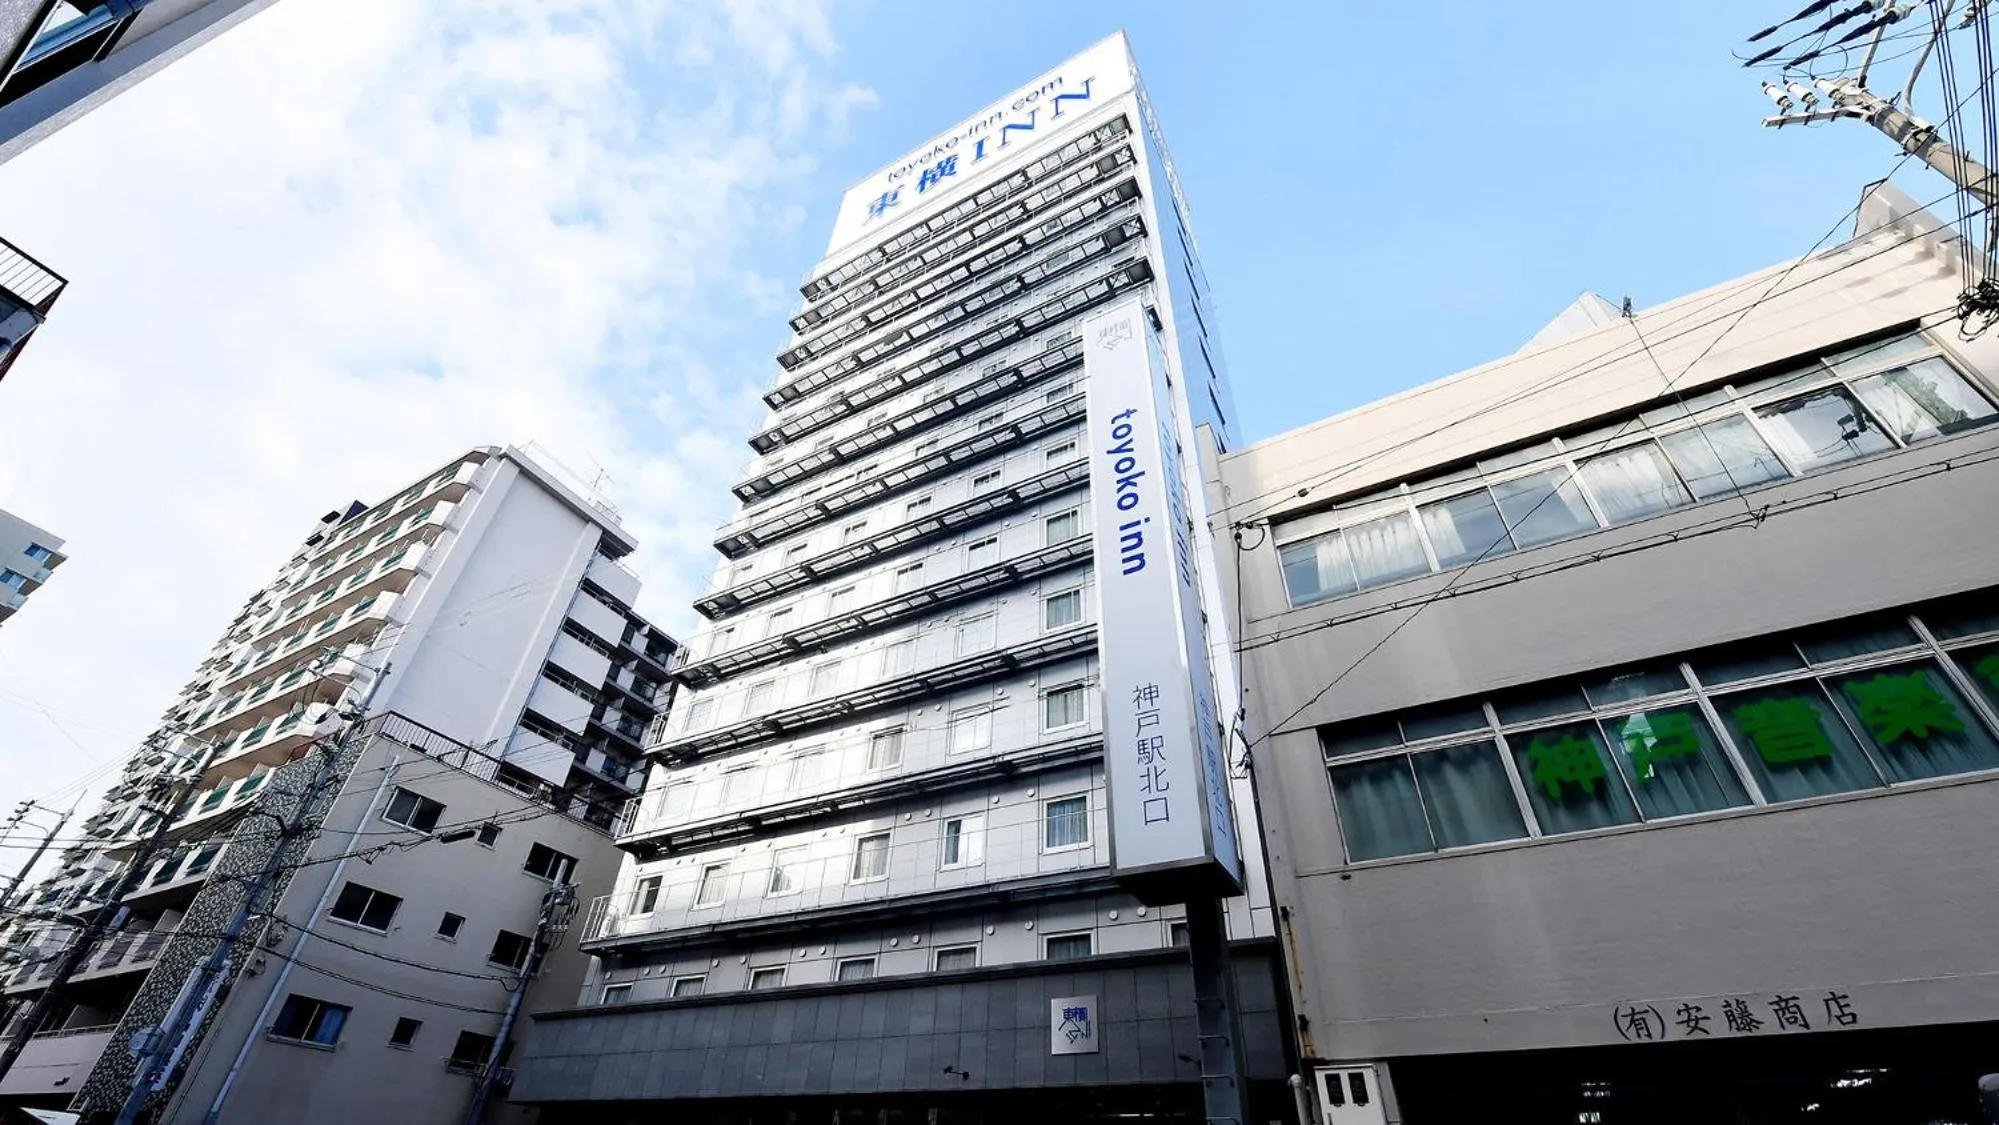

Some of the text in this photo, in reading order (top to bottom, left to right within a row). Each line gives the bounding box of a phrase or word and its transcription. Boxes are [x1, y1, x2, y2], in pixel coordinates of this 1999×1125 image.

[887, 76, 1063, 183] toyoko-inn.com
[1106, 408, 1151, 576] toyoko inn
[1132, 682, 1170, 826] 神戸駅北口
[1613, 991, 1859, 1041] (有)安藤商店
